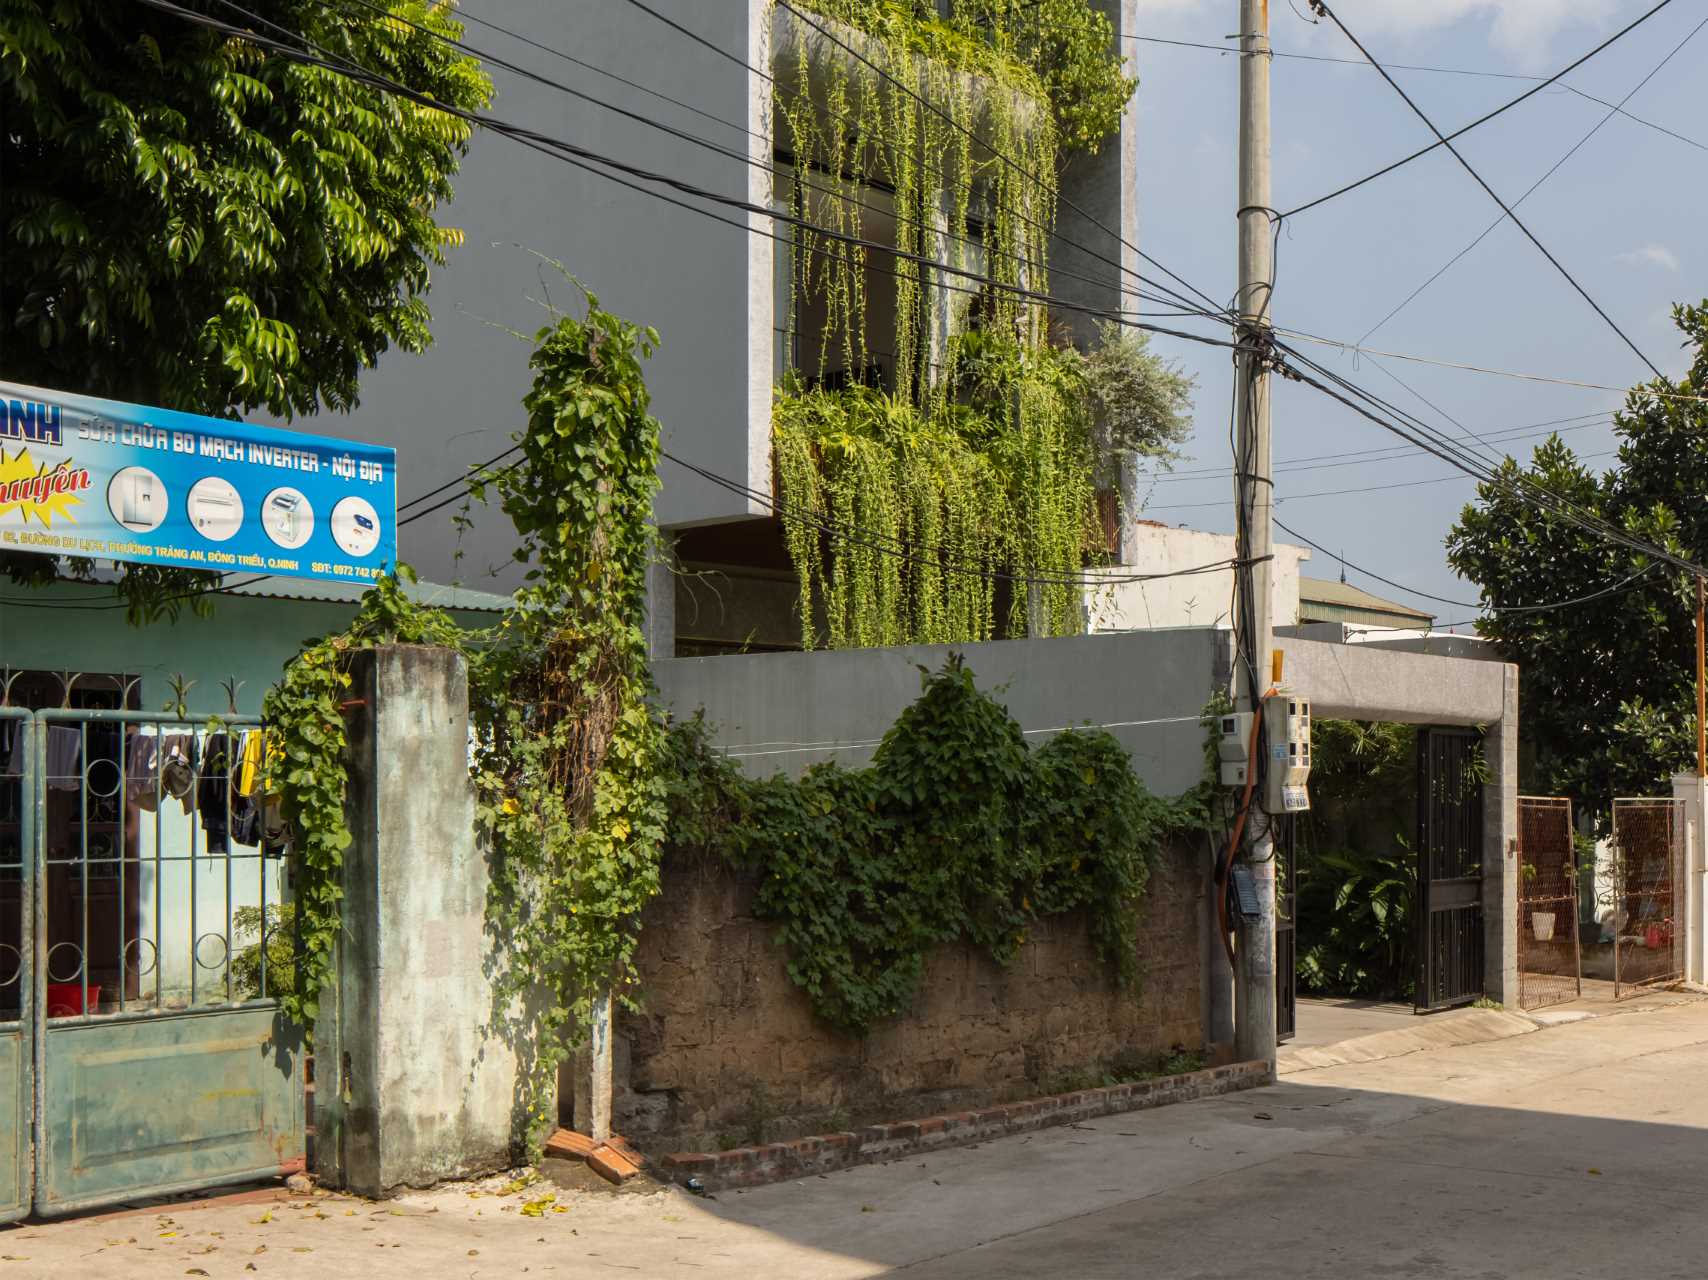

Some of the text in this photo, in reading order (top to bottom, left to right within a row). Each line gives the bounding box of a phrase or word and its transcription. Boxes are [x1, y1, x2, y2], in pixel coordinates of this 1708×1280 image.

[121, 422, 168, 451] CHỮA
[173, 431, 195, 455] BO
[200, 435, 244, 464] MẠCH
[248, 443, 319, 473] INVERTER
[332, 453, 356, 481] NỘI
[360, 460, 383, 485] ĐỊA
[190, 549, 206, 563] AN,
